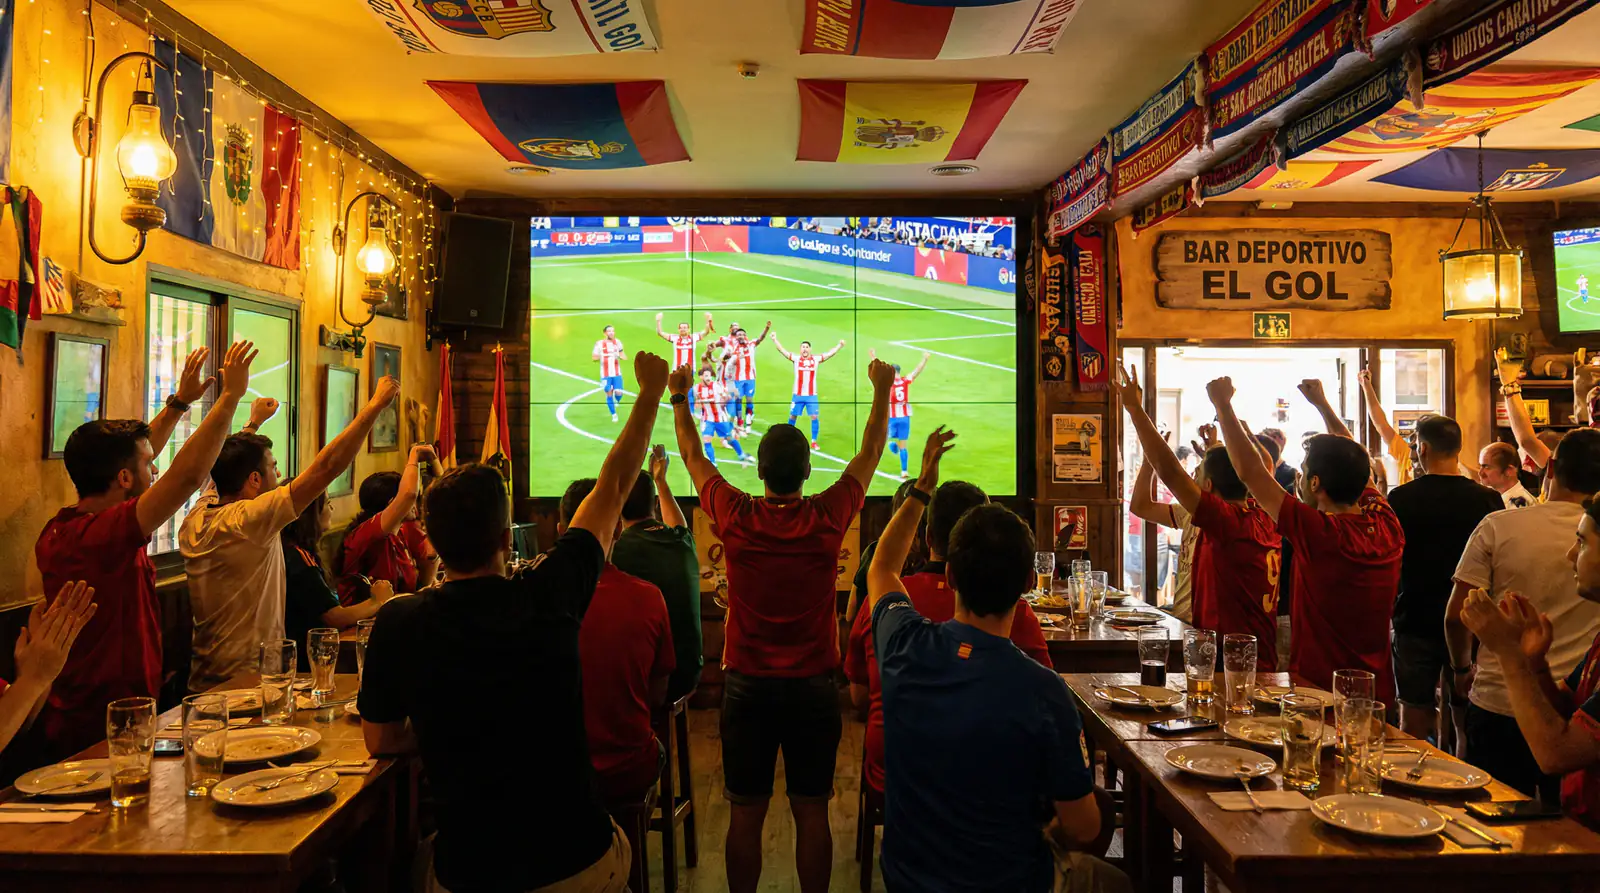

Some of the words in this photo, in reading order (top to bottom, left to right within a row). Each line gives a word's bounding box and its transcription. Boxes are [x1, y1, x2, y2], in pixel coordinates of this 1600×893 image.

[1452, 19, 1494, 61] UNITOS
[800, 239, 831, 254] LaLiga
[842, 244, 892, 263] Santander
[1184, 240, 1230, 264] BAR
[1238, 240, 1367, 264] DEPORTIVO
[1202, 270, 1251, 300] EL
[1265, 270, 1349, 301] GOL
